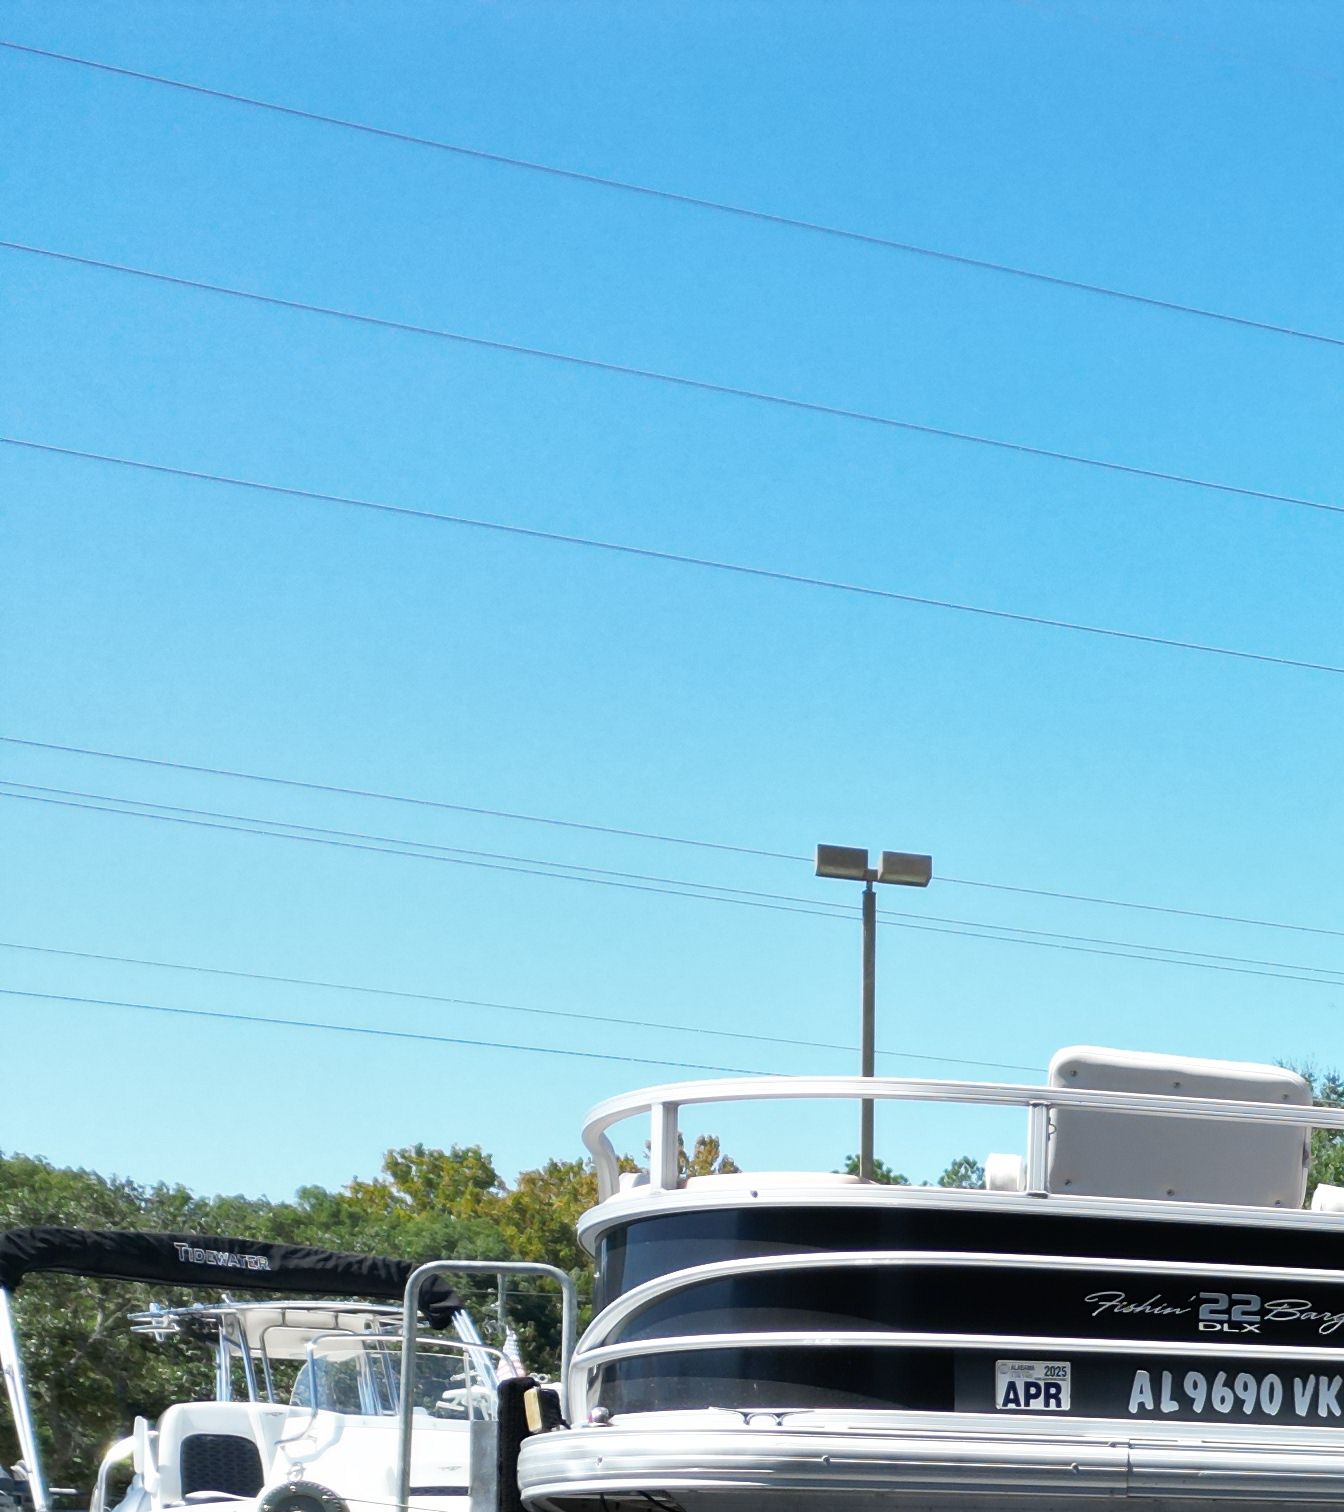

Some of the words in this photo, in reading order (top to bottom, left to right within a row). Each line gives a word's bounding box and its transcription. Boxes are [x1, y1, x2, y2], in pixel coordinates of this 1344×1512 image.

[173, 1242, 271, 1271] TIDEWATER
[1199, 1291, 1262, 1322] 22
[1198, 1322, 1262, 1333] DLX
[1044, 1365, 1068, 1378] 2025
[1001, 1381, 1063, 1409] APR
[1293, 1374, 1343, 1417] VK
